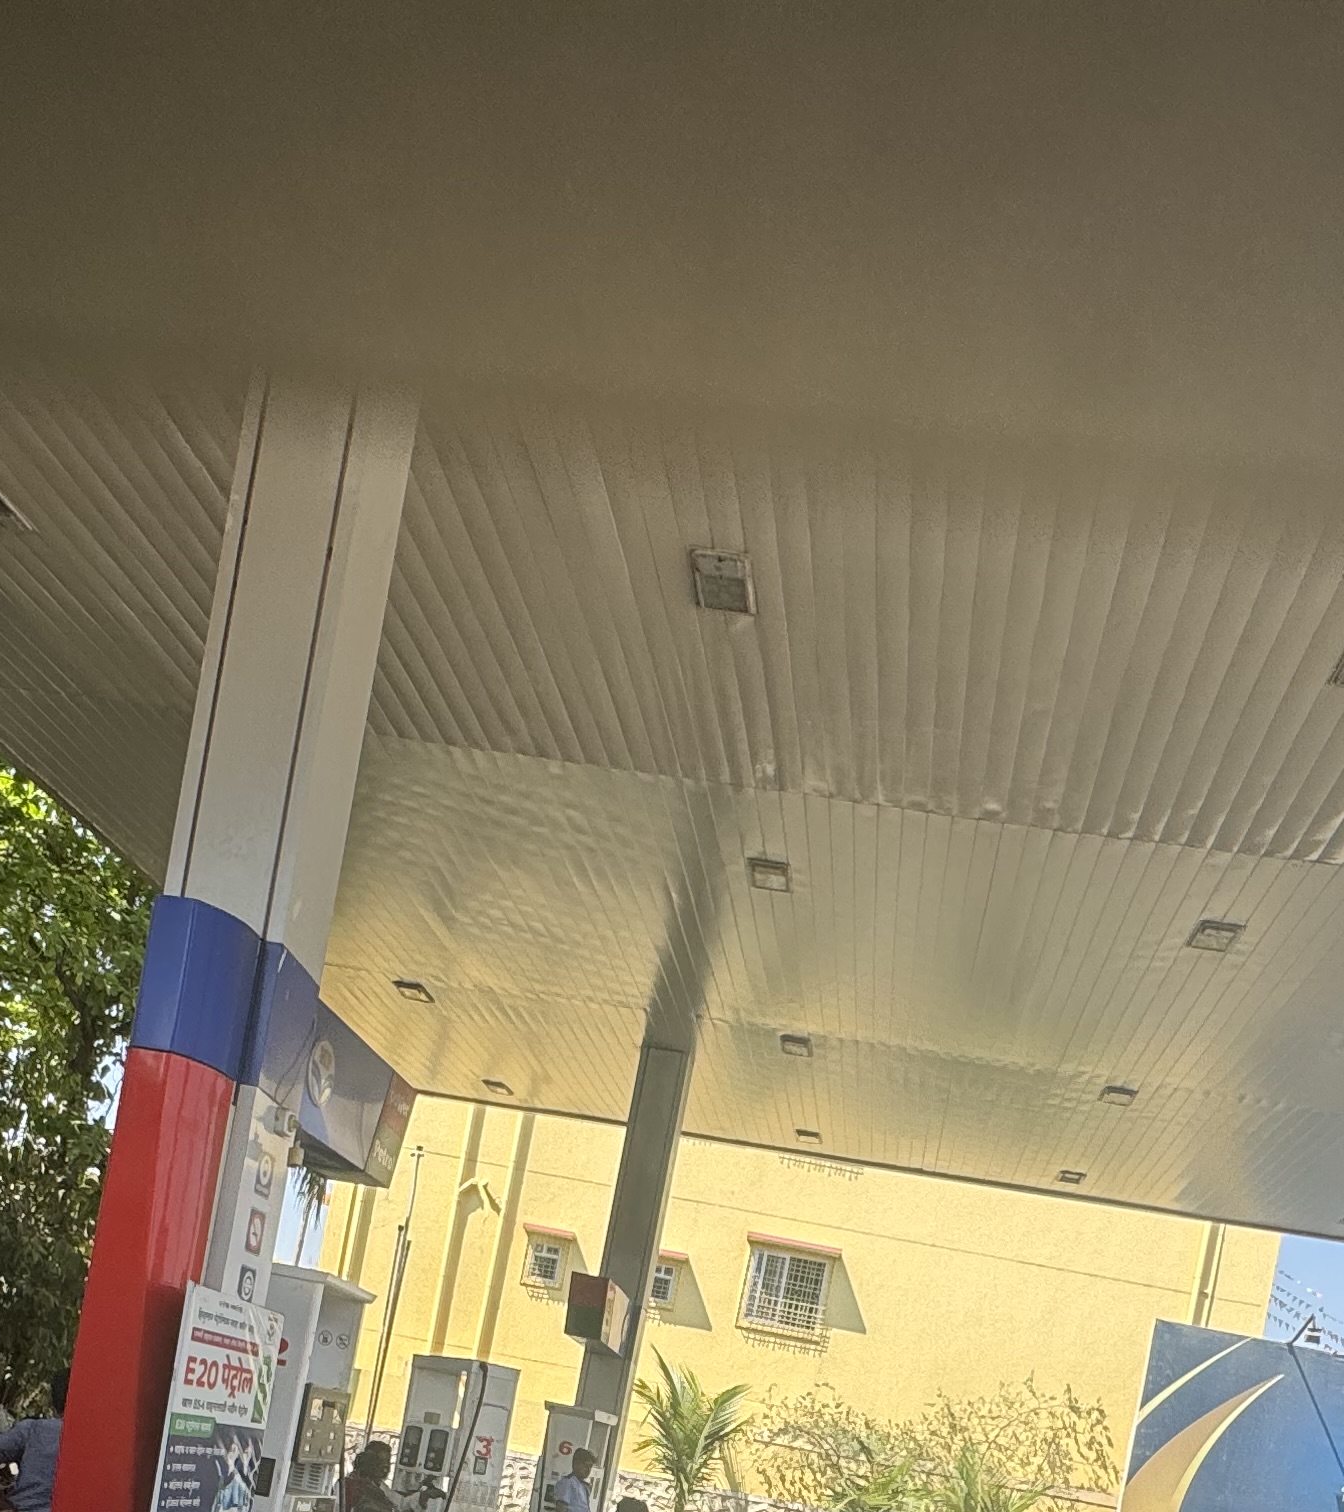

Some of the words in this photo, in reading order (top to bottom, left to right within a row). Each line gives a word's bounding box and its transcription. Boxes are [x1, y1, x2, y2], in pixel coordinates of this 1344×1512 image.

[183, 1355, 219, 1391] E20
[221, 1353, 254, 1399] पेट्रोल
[476, 1436, 494, 1459] 3
[559, 1441, 573, 1455] 6
